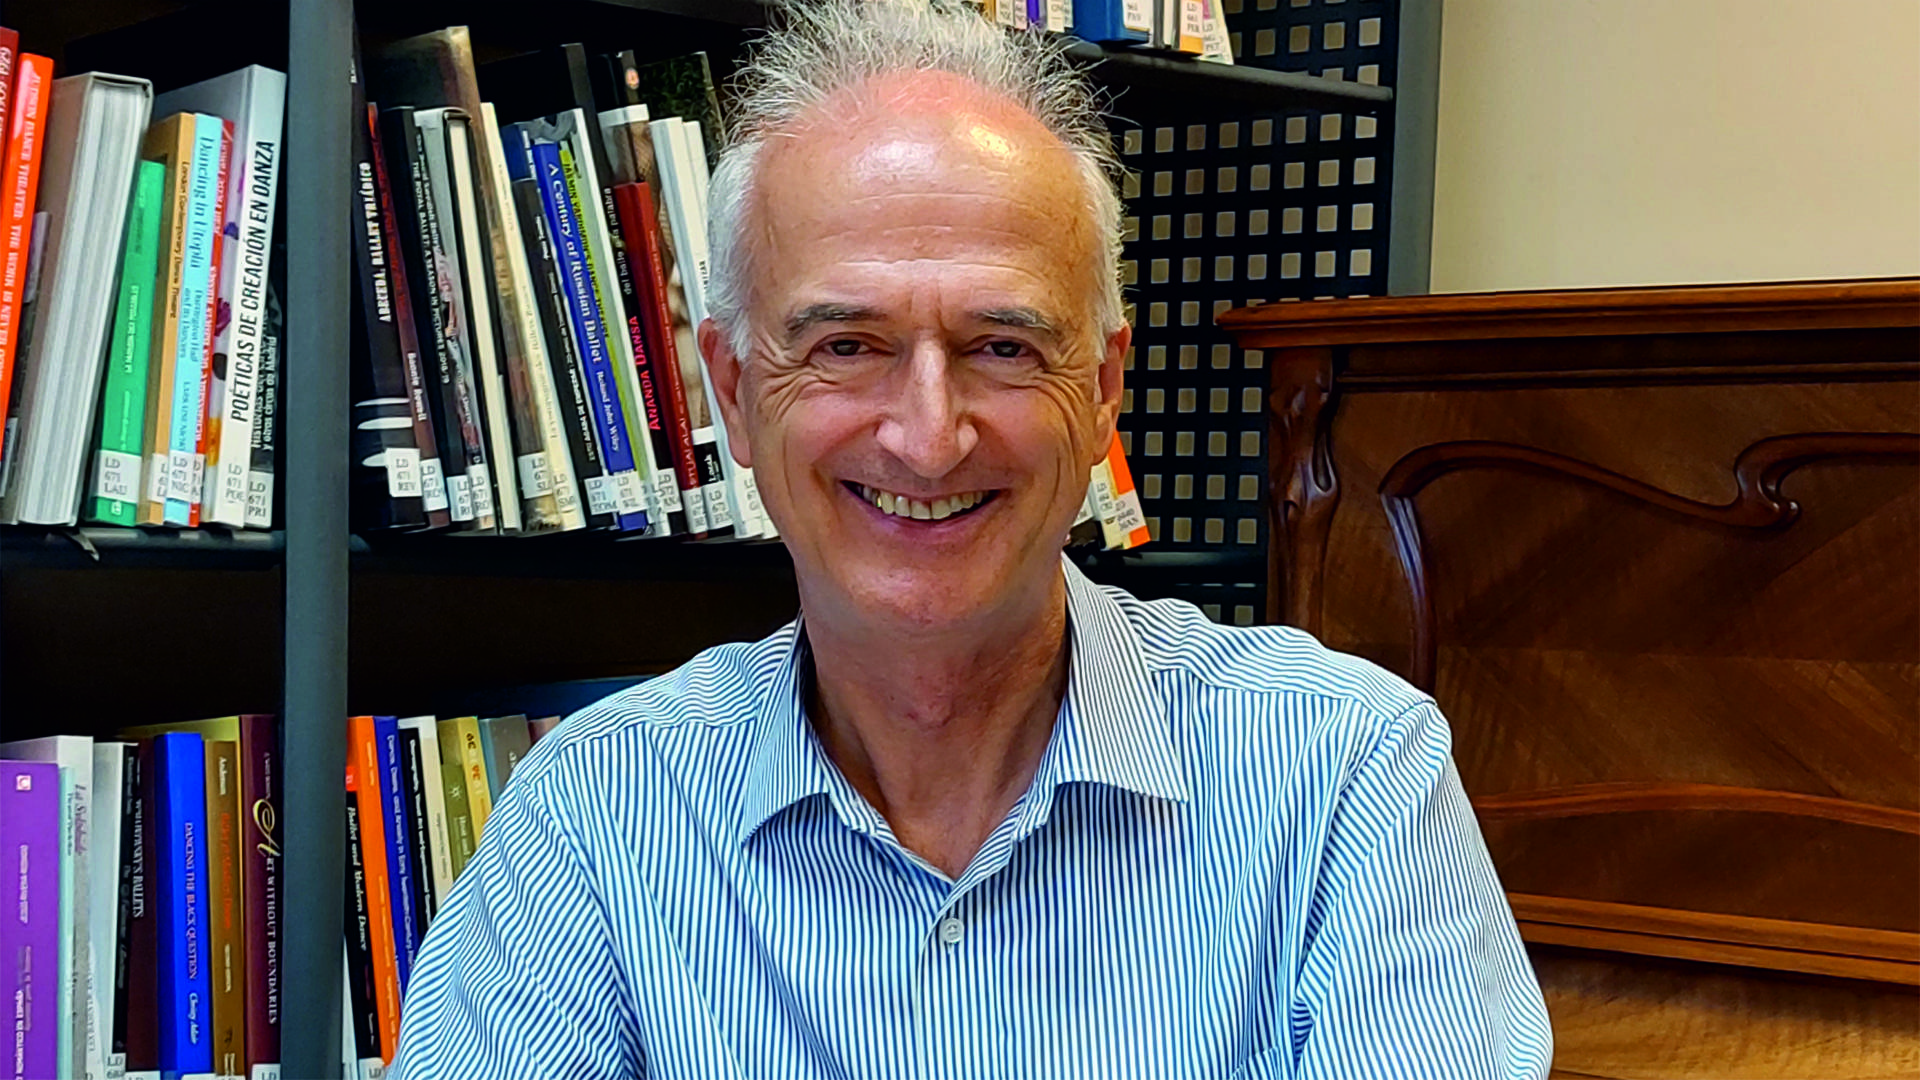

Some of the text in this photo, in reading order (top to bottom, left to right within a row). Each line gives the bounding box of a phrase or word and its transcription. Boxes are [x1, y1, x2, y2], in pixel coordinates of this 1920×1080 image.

[25, 71, 40, 118] JUDSON
[20, 120, 34, 160] DANCE
[179, 160, 189, 193] London
[193, 136, 213, 198] Dancing
[412, 161, 420, 178] THE
[359, 162, 376, 218] TRIÁDICO
[414, 180, 424, 209] ROYAL
[603, 187, 617, 226] palabra
[9, 224, 21, 248] THE
[366, 221, 383, 265] BALLET
[423, 249, 431, 257] A
[548, 163, 601, 362] A Century of Russian Ballet
[616, 250, 628, 276] baile
[4, 251, 17, 286] WORK
[231, 141, 273, 421] POÉTICAS DE CREACIÓN EN DANZA
[425, 258, 436, 294] SEASON
[2, 290, 13, 302] IS
[430, 295, 438, 306] IN
[621, 278, 632, 295] del
[433, 307, 444, 349] PICTURES
[264, 335, 276, 371] Madrid
[628, 315, 661, 432] ANANDA DANSA
[262, 416, 272, 442] otros
[105, 457, 120, 469] LD
[174, 456, 188, 467] LD
[228, 463, 242, 475] LD
[396, 459, 408, 468] LD
[421, 466, 436, 475] LD
[532, 458, 545, 469] LD
[249, 481, 266, 493] LD
[472, 477, 484, 487] LD
[554, 474, 567, 484] LD
[618, 476, 629, 486] LD
[347, 806, 366, 950] Ballet and Modern Dance
[132, 874, 144, 917] BALLETS
[184, 821, 197, 979] DANCING THE BLACK QUESTION
[266, 875, 276, 937] WITHOUT
[267, 940, 277, 1023] BOUNDARIES
[107, 1056, 123, 1066] LD
